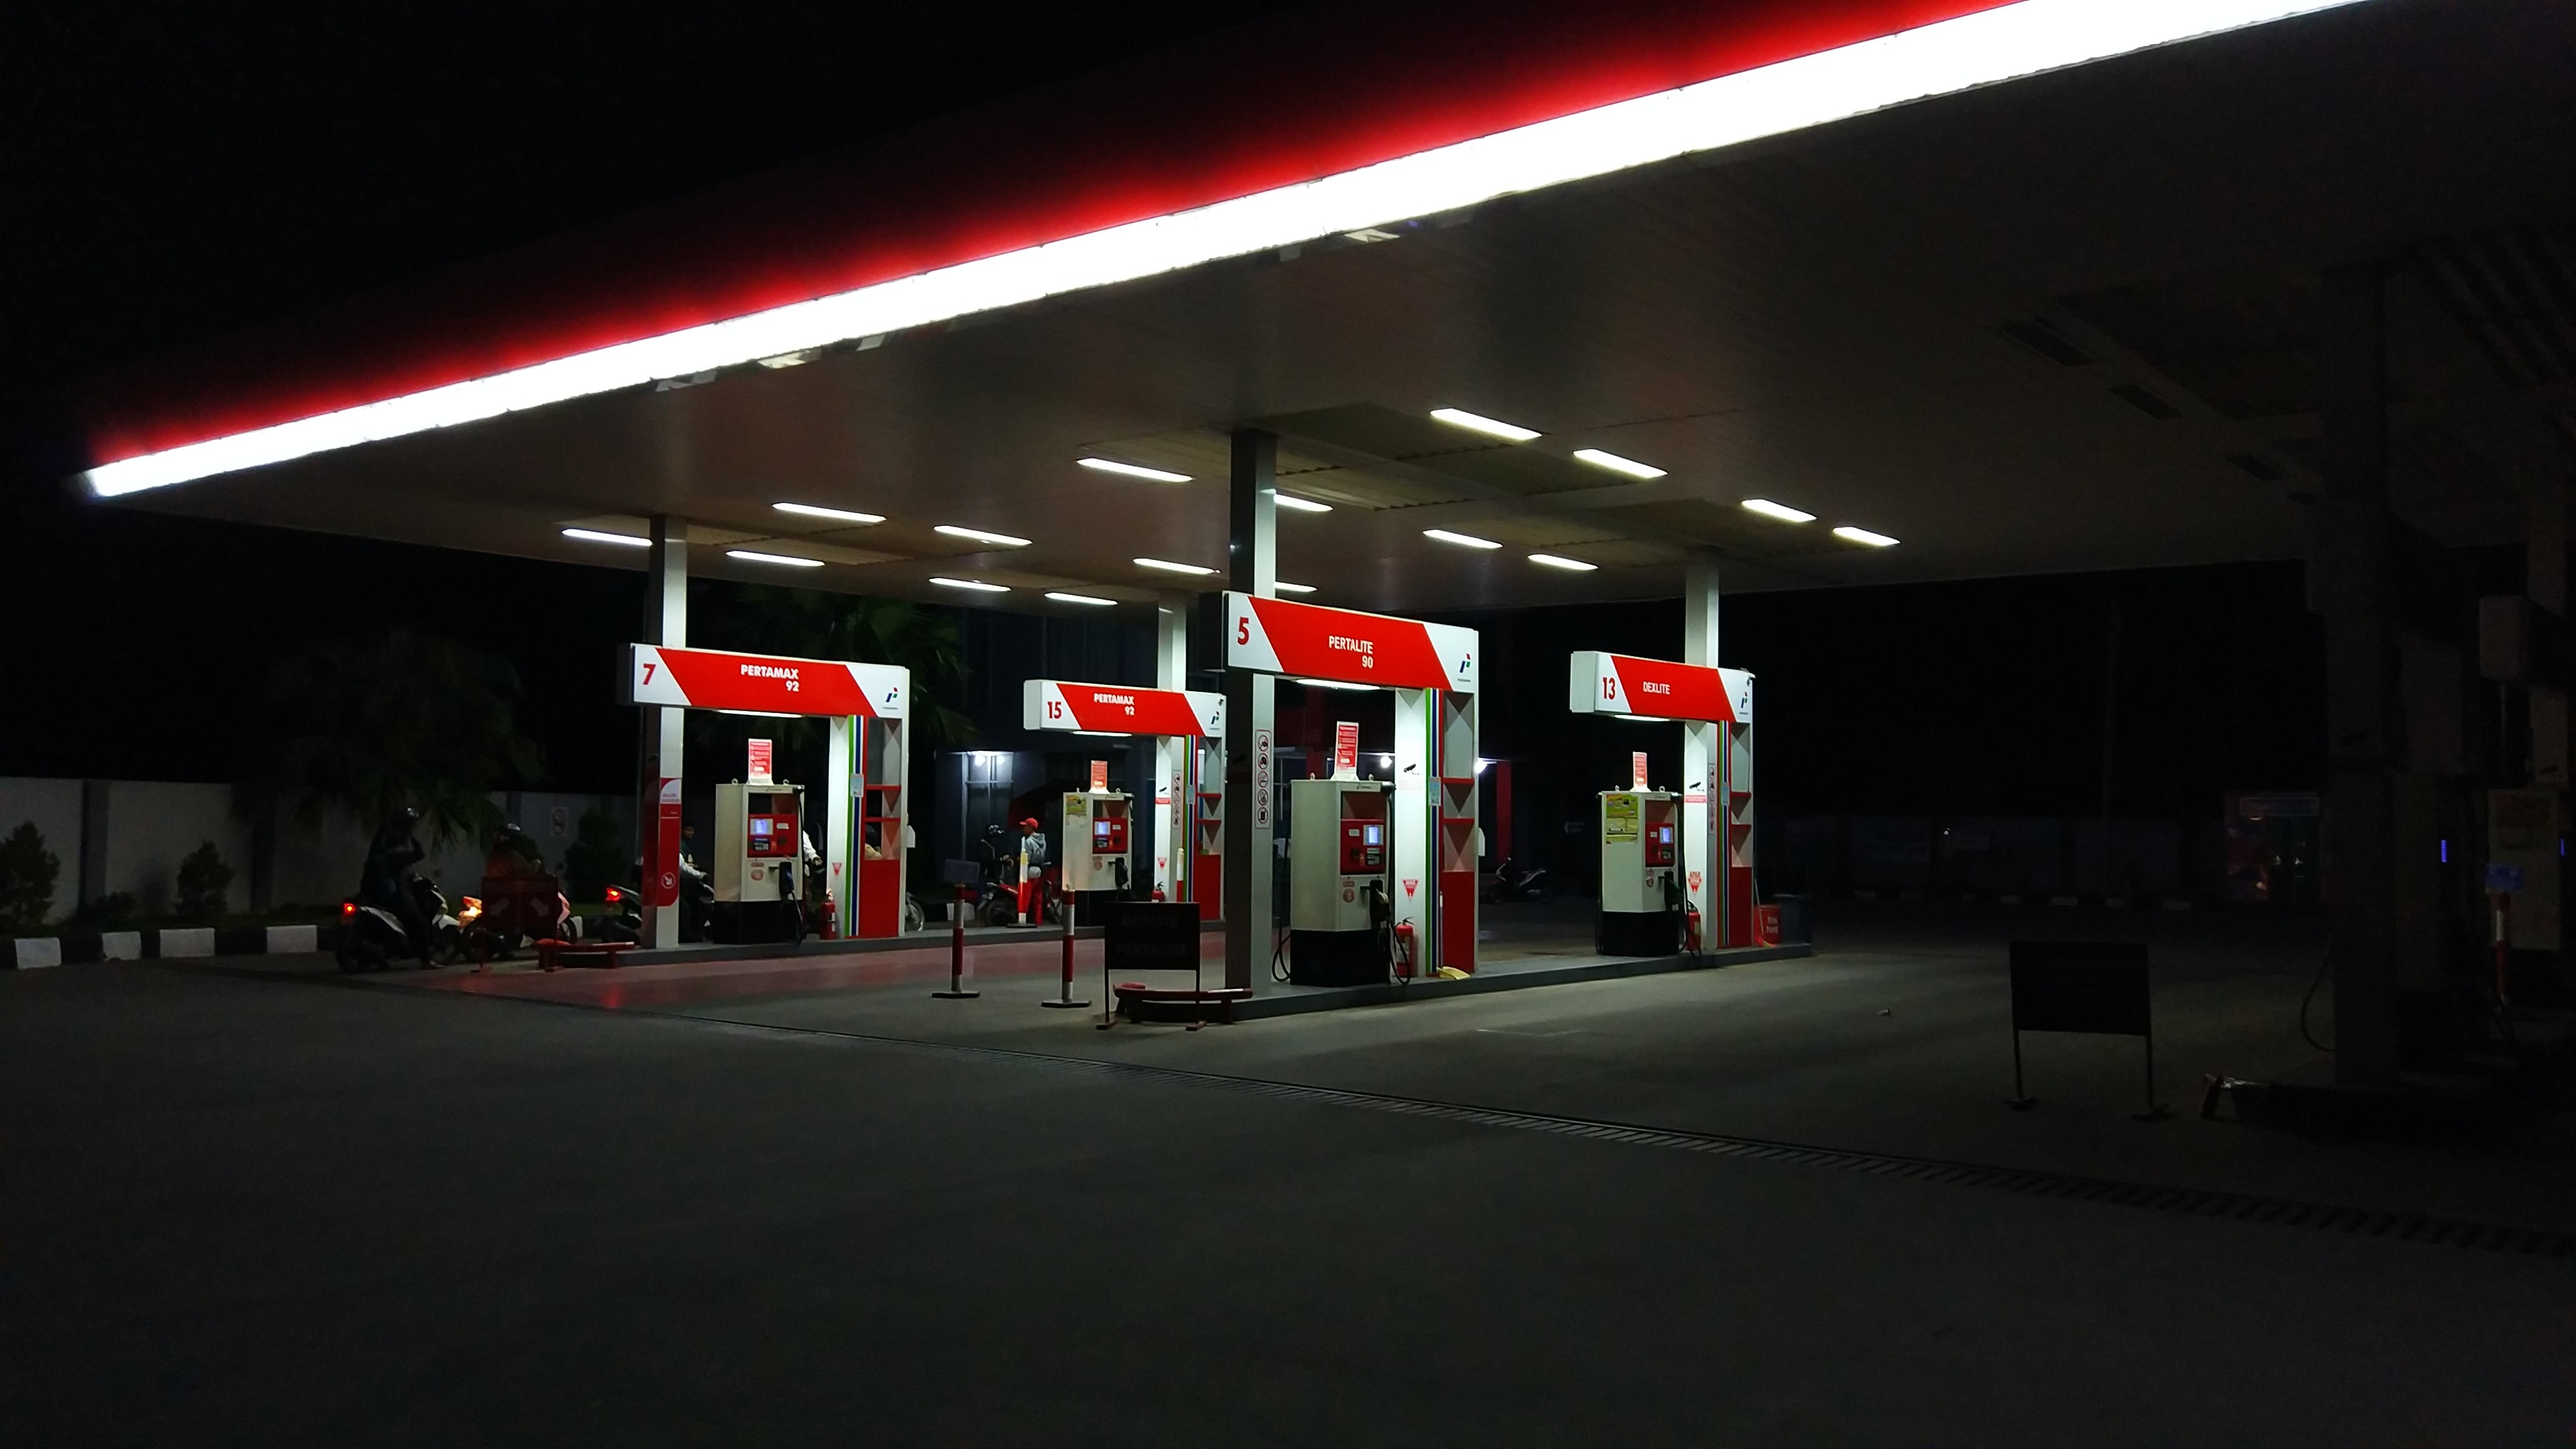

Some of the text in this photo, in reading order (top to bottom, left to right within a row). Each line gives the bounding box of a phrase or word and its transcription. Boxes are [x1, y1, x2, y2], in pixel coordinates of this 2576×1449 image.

[1237, 616, 1250, 645] 5
[1329, 635, 1374, 655] PERTALITE
[1362, 655, 1374, 668] 90
[643, 663, 656, 685] 7
[741, 663, 799, 679] PERTAMAX
[786, 680, 800, 692] 92
[1603, 676, 1615, 700] 13
[1643, 681, 1670, 695] DEXLITE
[1093, 693, 1134, 705] PERTAMAX
[1047, 701, 1062, 719] 15
[1124, 706, 1135, 716] 92
